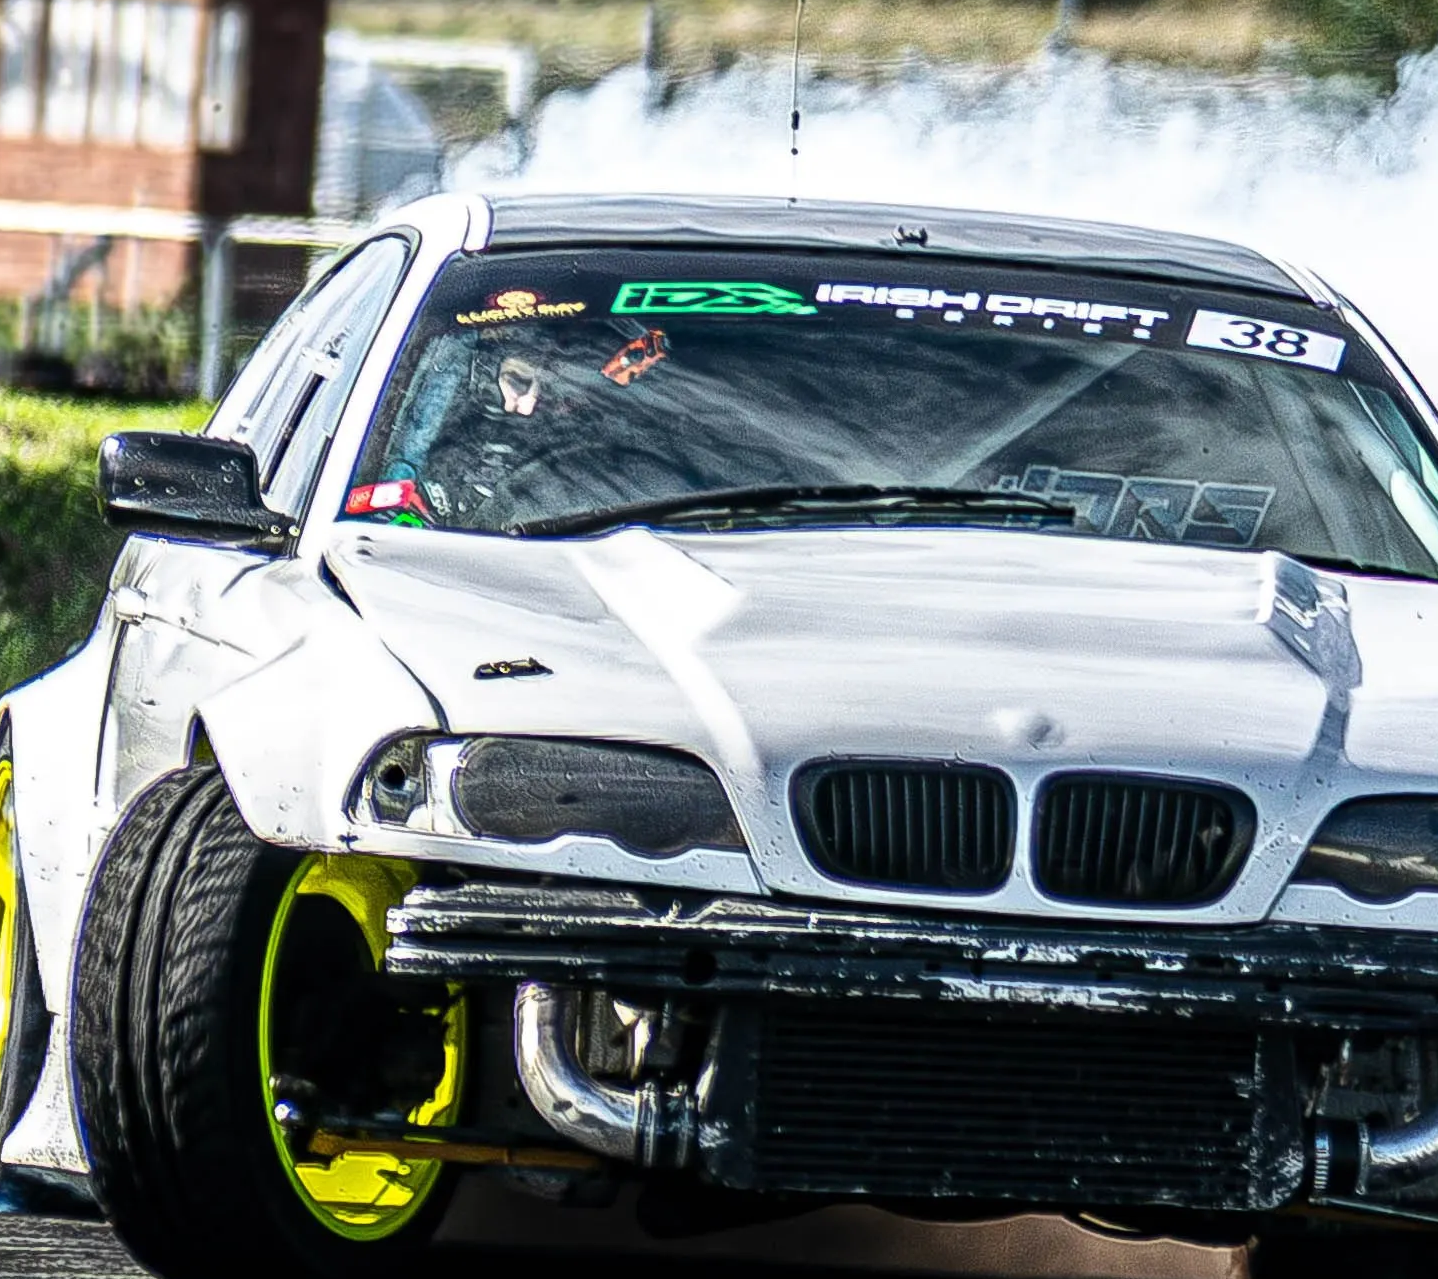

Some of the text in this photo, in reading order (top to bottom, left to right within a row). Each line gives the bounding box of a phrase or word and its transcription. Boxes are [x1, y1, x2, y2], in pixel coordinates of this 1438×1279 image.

[814, 283, 1170, 327] IRISH DRIFT
[1219, 319, 1310, 358] 38
